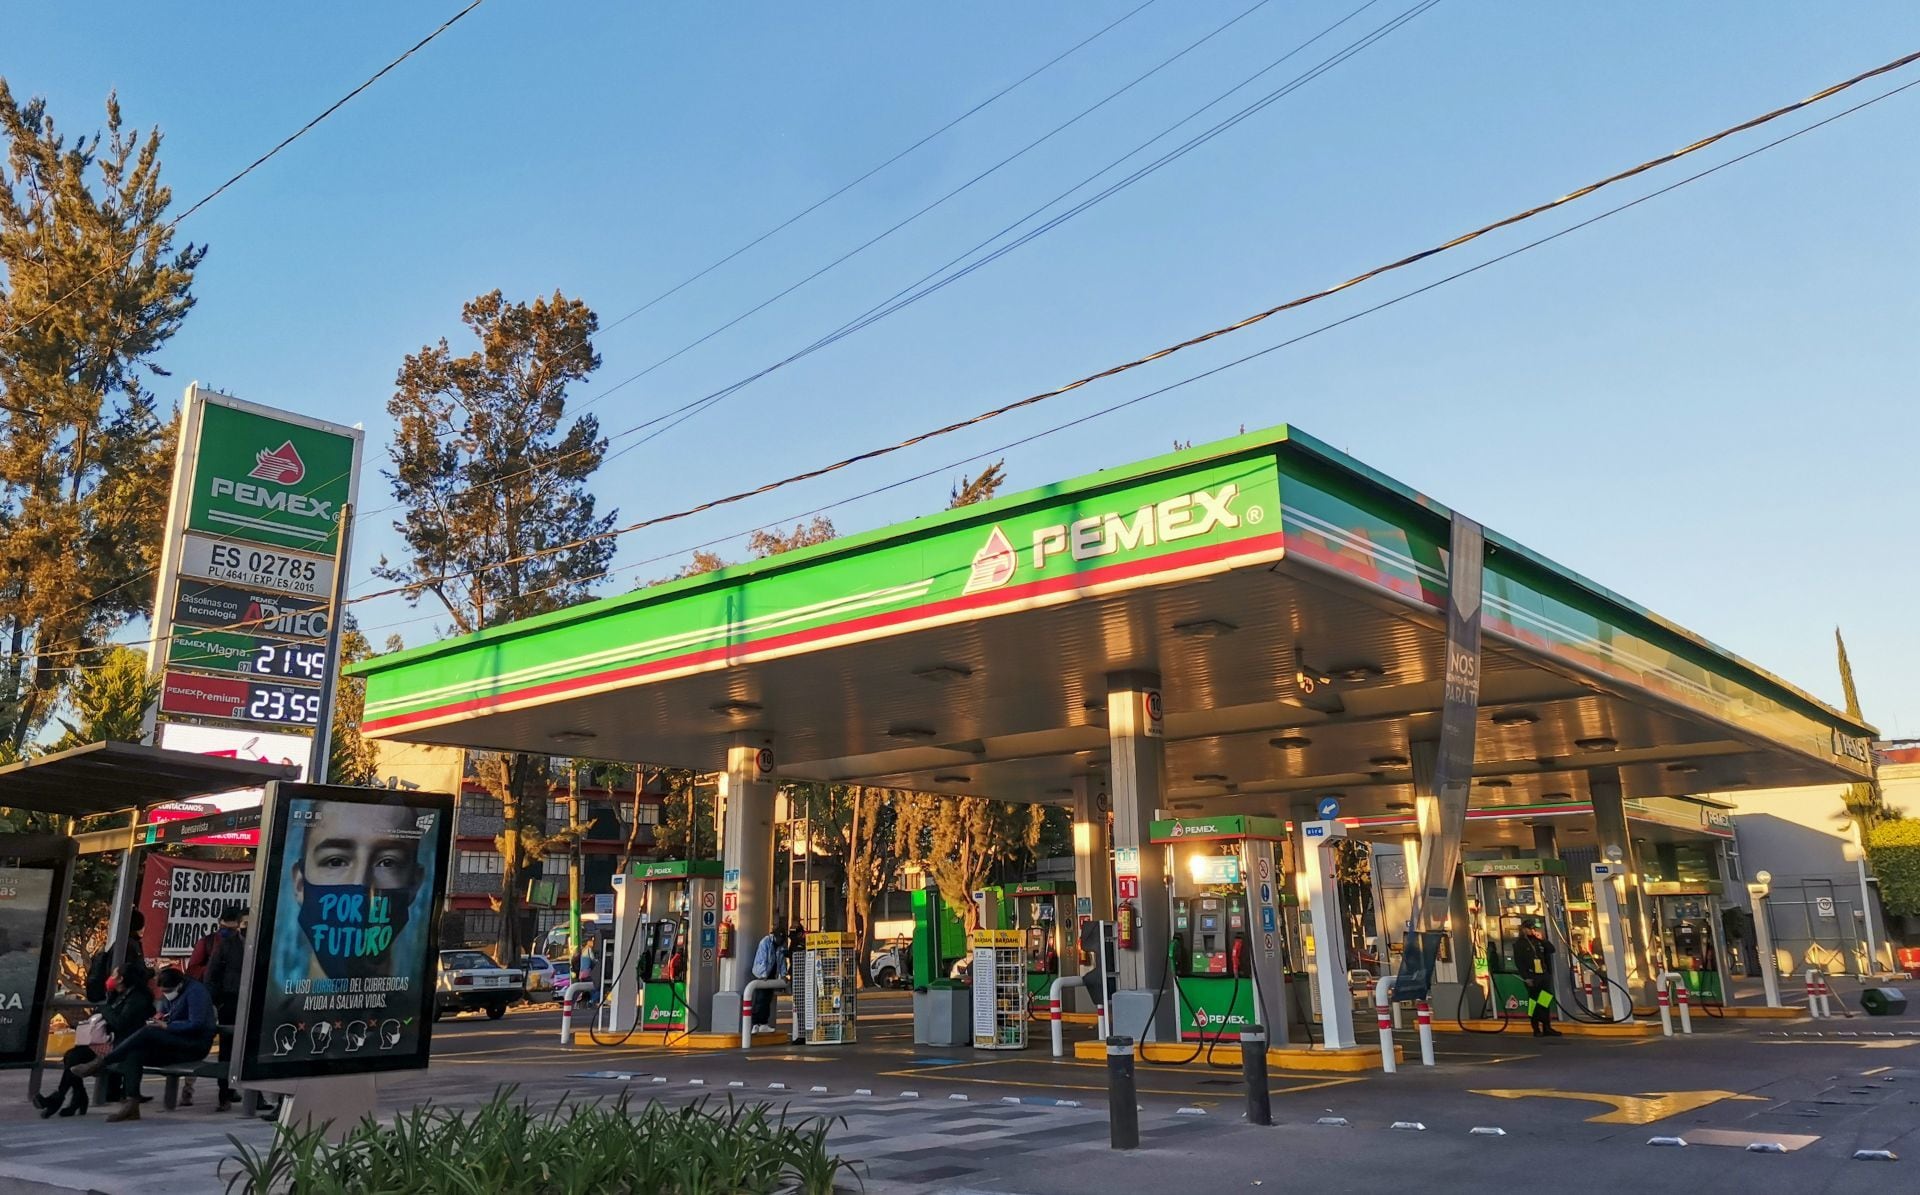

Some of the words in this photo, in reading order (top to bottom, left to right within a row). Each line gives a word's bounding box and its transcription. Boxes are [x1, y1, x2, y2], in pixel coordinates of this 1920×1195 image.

[211, 478, 332, 520] PEMEX
[1033, 484, 1241, 569] PEMEX
[210, 544, 241, 569] ES
[249, 552, 316, 581] 02785
[181, 593, 221, 608] Gasolinas
[222, 600, 238, 610] con
[250, 595, 279, 606] PEMEX
[188, 605, 237, 620] tecnología
[173, 638, 206, 649] PEMEX
[207, 642, 247, 658] Magna
[239, 662, 249, 671] 87
[1451, 652, 1474, 676] NOS
[166, 686, 197, 696] PEMEX
[196, 689, 240, 703] Premium
[1445, 684, 1467, 705] PARA
[1468, 689, 1478, 707] TI
[763, 753, 772, 764] 10
[180, 821, 209, 835] Buenavista
[1185, 825, 1216, 834] PEMEX
[1235, 818, 1241, 833] 1
[1533, 861, 1541, 870] 5
[173, 871, 192, 892] SE
[193, 872, 251, 893] SOLICITA
[319, 893, 363, 922] POR
[367, 896, 391, 924] EL
[311, 924, 393, 957] FUTURO
[284, 979, 294, 994] EL
[295, 979, 311, 994] USO
[311, 978, 349, 993] CORRECTO
[349, 978, 363, 992] DEL
[363, 976, 409, 992] CUBREBOCAS
[303, 996, 328, 1011] AYUDA
[329, 996, 335, 1010] A
[335, 994, 363, 1010] SALVAR
[365, 993, 387, 1008] VIDAS.
[1209, 1015, 1245, 1024] PEMEX
